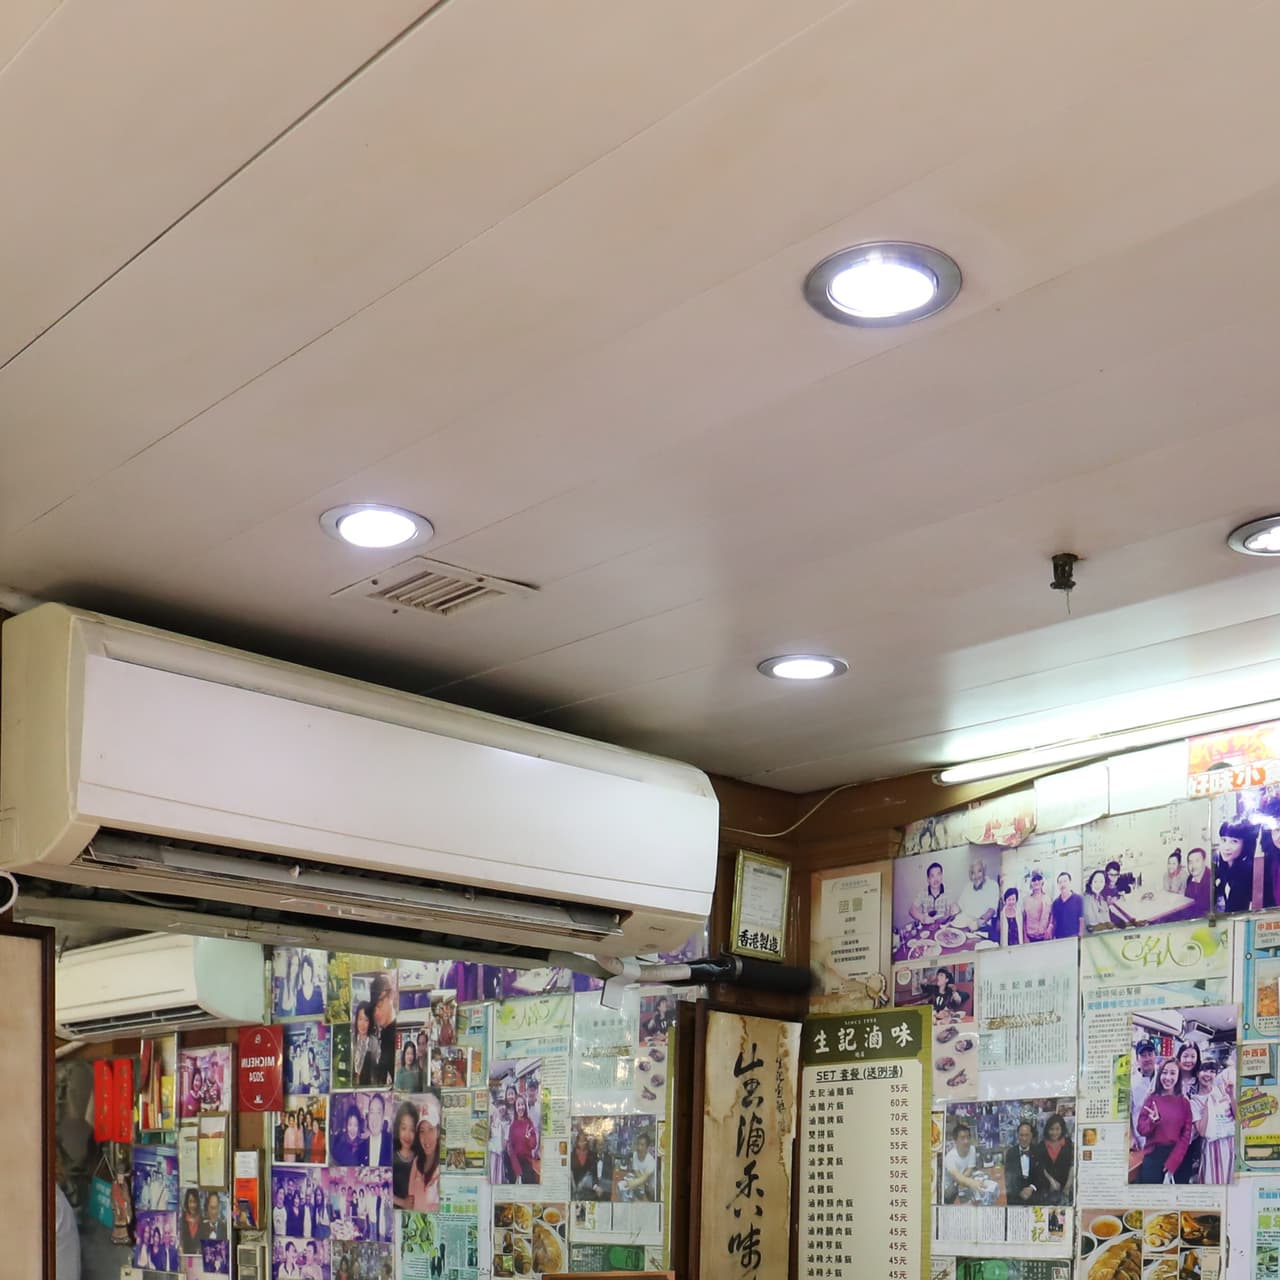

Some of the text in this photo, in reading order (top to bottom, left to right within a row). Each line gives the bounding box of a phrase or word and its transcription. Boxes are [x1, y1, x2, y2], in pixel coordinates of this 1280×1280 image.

[813, 1022, 914, 1054] 生記滷味
[816, 1070, 837, 1081] SET
[890, 1084, 909, 1093] 55元
[890, 1098, 909, 1107] 60元
[890, 1113, 909, 1121] 70元
[890, 1127, 908, 1136] 55元
[890, 1142, 908, 1150] 55元
[889, 1156, 908, 1164] 55元
[889, 1170, 908, 1179] 50元
[889, 1184, 908, 1193] 50元
[889, 1199, 908, 1207] 45元
[889, 1213, 908, 1222] 45元
[889, 1227, 908, 1236] 45元
[889, 1242, 908, 1250] 45元
[889, 1256, 908, 1265] 45元
[889, 1270, 907, 1279] 45元
